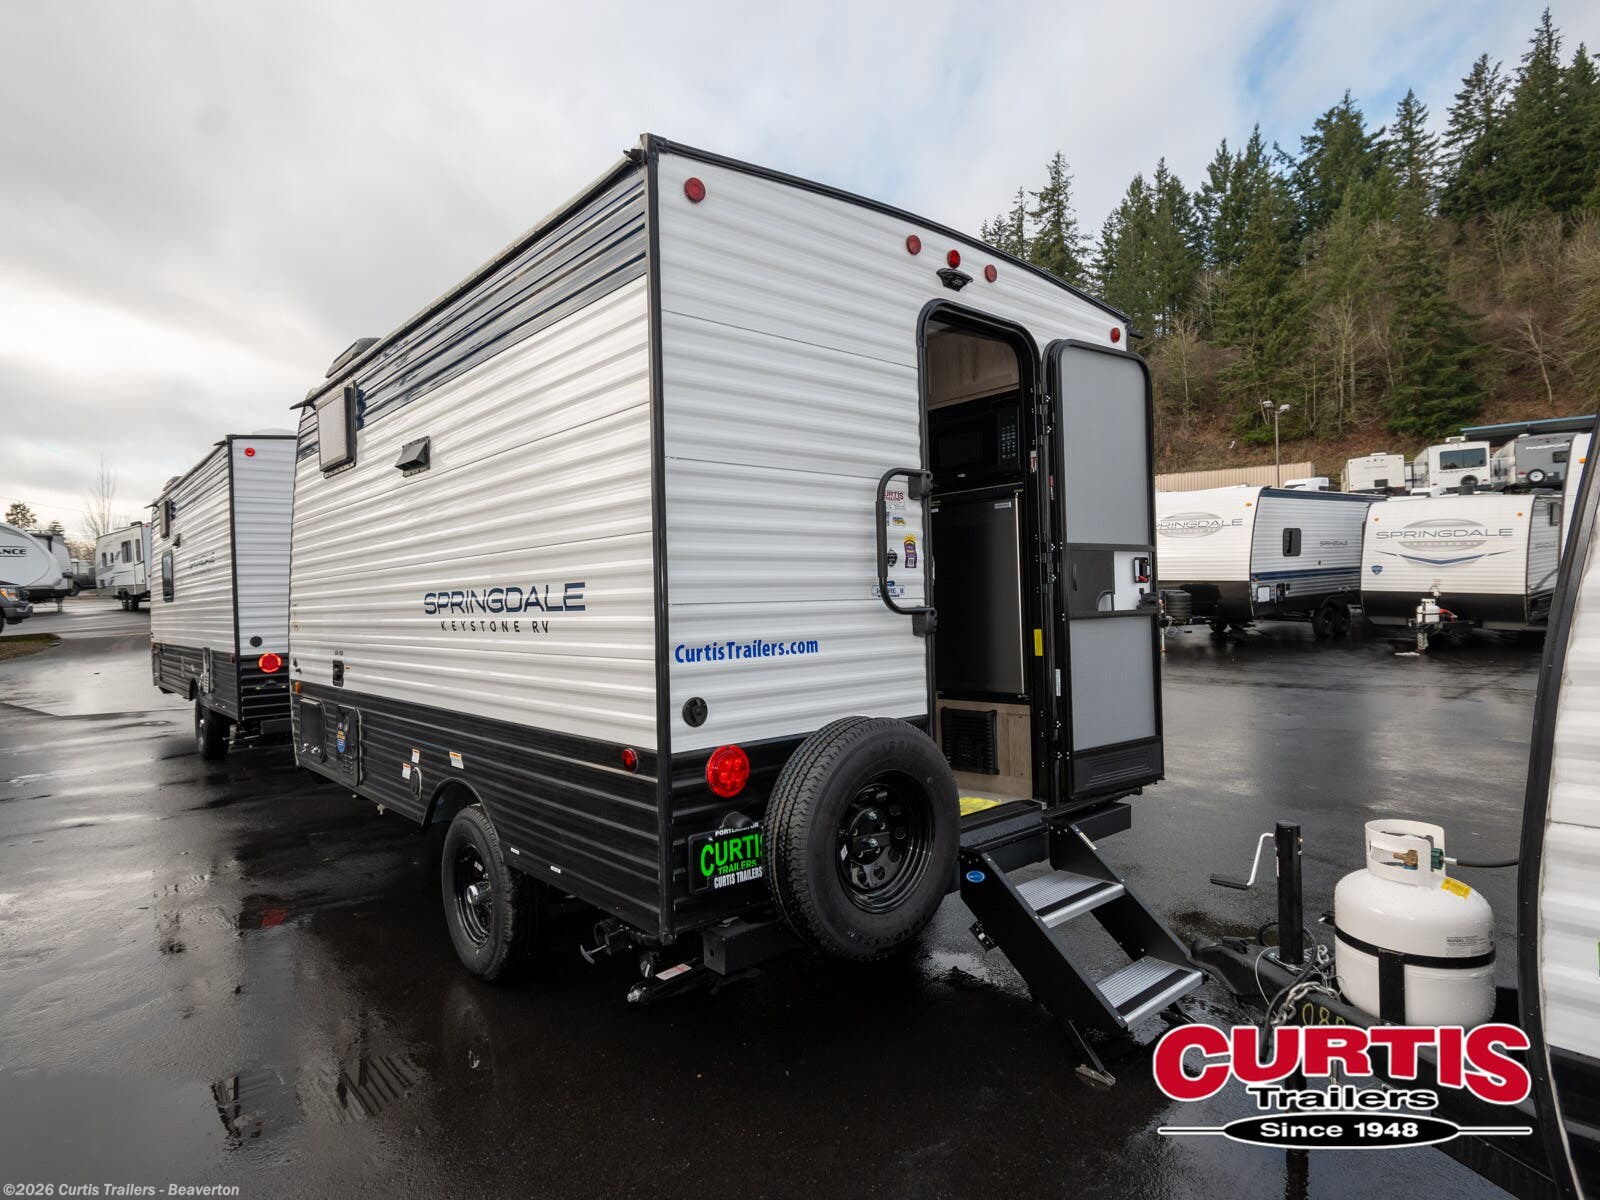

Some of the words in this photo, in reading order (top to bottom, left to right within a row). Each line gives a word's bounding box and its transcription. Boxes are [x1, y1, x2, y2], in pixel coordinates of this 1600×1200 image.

[1376, 528, 1514, 540] SPRINGDALE
[423, 582, 586, 615] SPRINGDALE
[440, 620, 520, 633] KEYSTONE
[532, 619, 550, 634] RV
[675, 639, 819, 664] CurtisTrailers.com
[700, 834, 763, 877] CURTI
[717, 859, 757, 875] TRAILERS
[714, 873, 736, 889] CURTIS
[736, 866, 763, 883] TRAILERS
